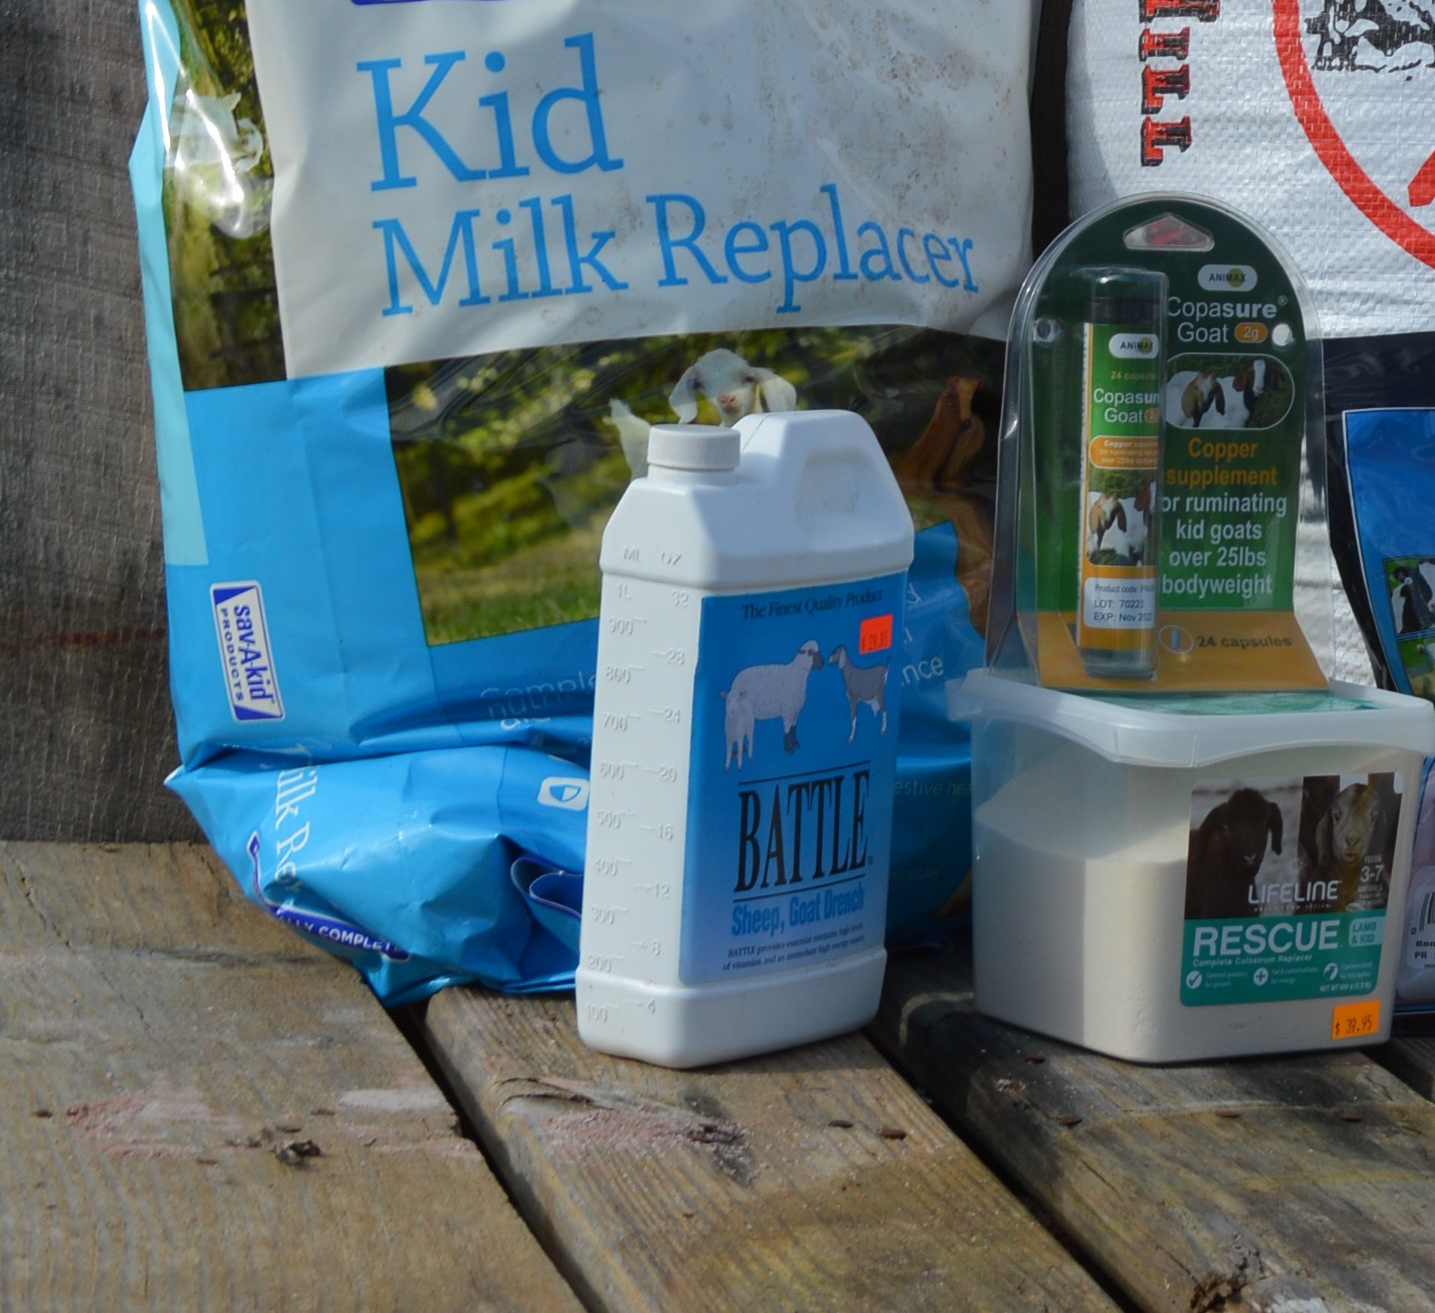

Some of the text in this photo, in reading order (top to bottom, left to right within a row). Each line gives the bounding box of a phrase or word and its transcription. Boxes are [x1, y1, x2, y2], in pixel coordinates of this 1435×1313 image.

[356, 34, 623, 193] Kid
[371, 185, 980, 317] Milk Replacer
[1208, 272, 1247, 283] ANIMAX
[1168, 295, 1278, 323] Copasure
[1177, 321, 1259, 344] Goat 2g
[1104, 407, 1143, 423] Goat
[1188, 437, 1258, 464] Copper
[1166, 465, 1278, 490] supplement
[1186, 493, 1288, 518] ruminating
[1176, 519, 1263, 545] kid goats
[1169, 545, 1267, 567] over 25lbs
[1161, 573, 1273, 599] bodyweight
[742, 603, 767, 620] The
[768, 600, 802, 617] Finest
[805, 596, 842, 615] Quality
[846, 588, 883, 607] Product
[221, 608, 244, 701] PRODUCTS
[1197, 635, 1294, 650] 24 capsules
[733, 769, 871, 893] BATTLE
[1360, 865, 1384, 882] 3-7
[1248, 880, 1340, 904] LIFELINE
[731, 881, 865, 937] Sheep, Goat Drench
[1193, 920, 1341, 957] RESCUE
[1352, 921, 1377, 933] LAMB
[1360, 933, 1375, 944] KID
[1193, 953, 1313, 968] Complete Colostrum Replacer
[1414, 951, 1428, 960] PR
[1334, 1014, 1373, 1036] $ 39.95
